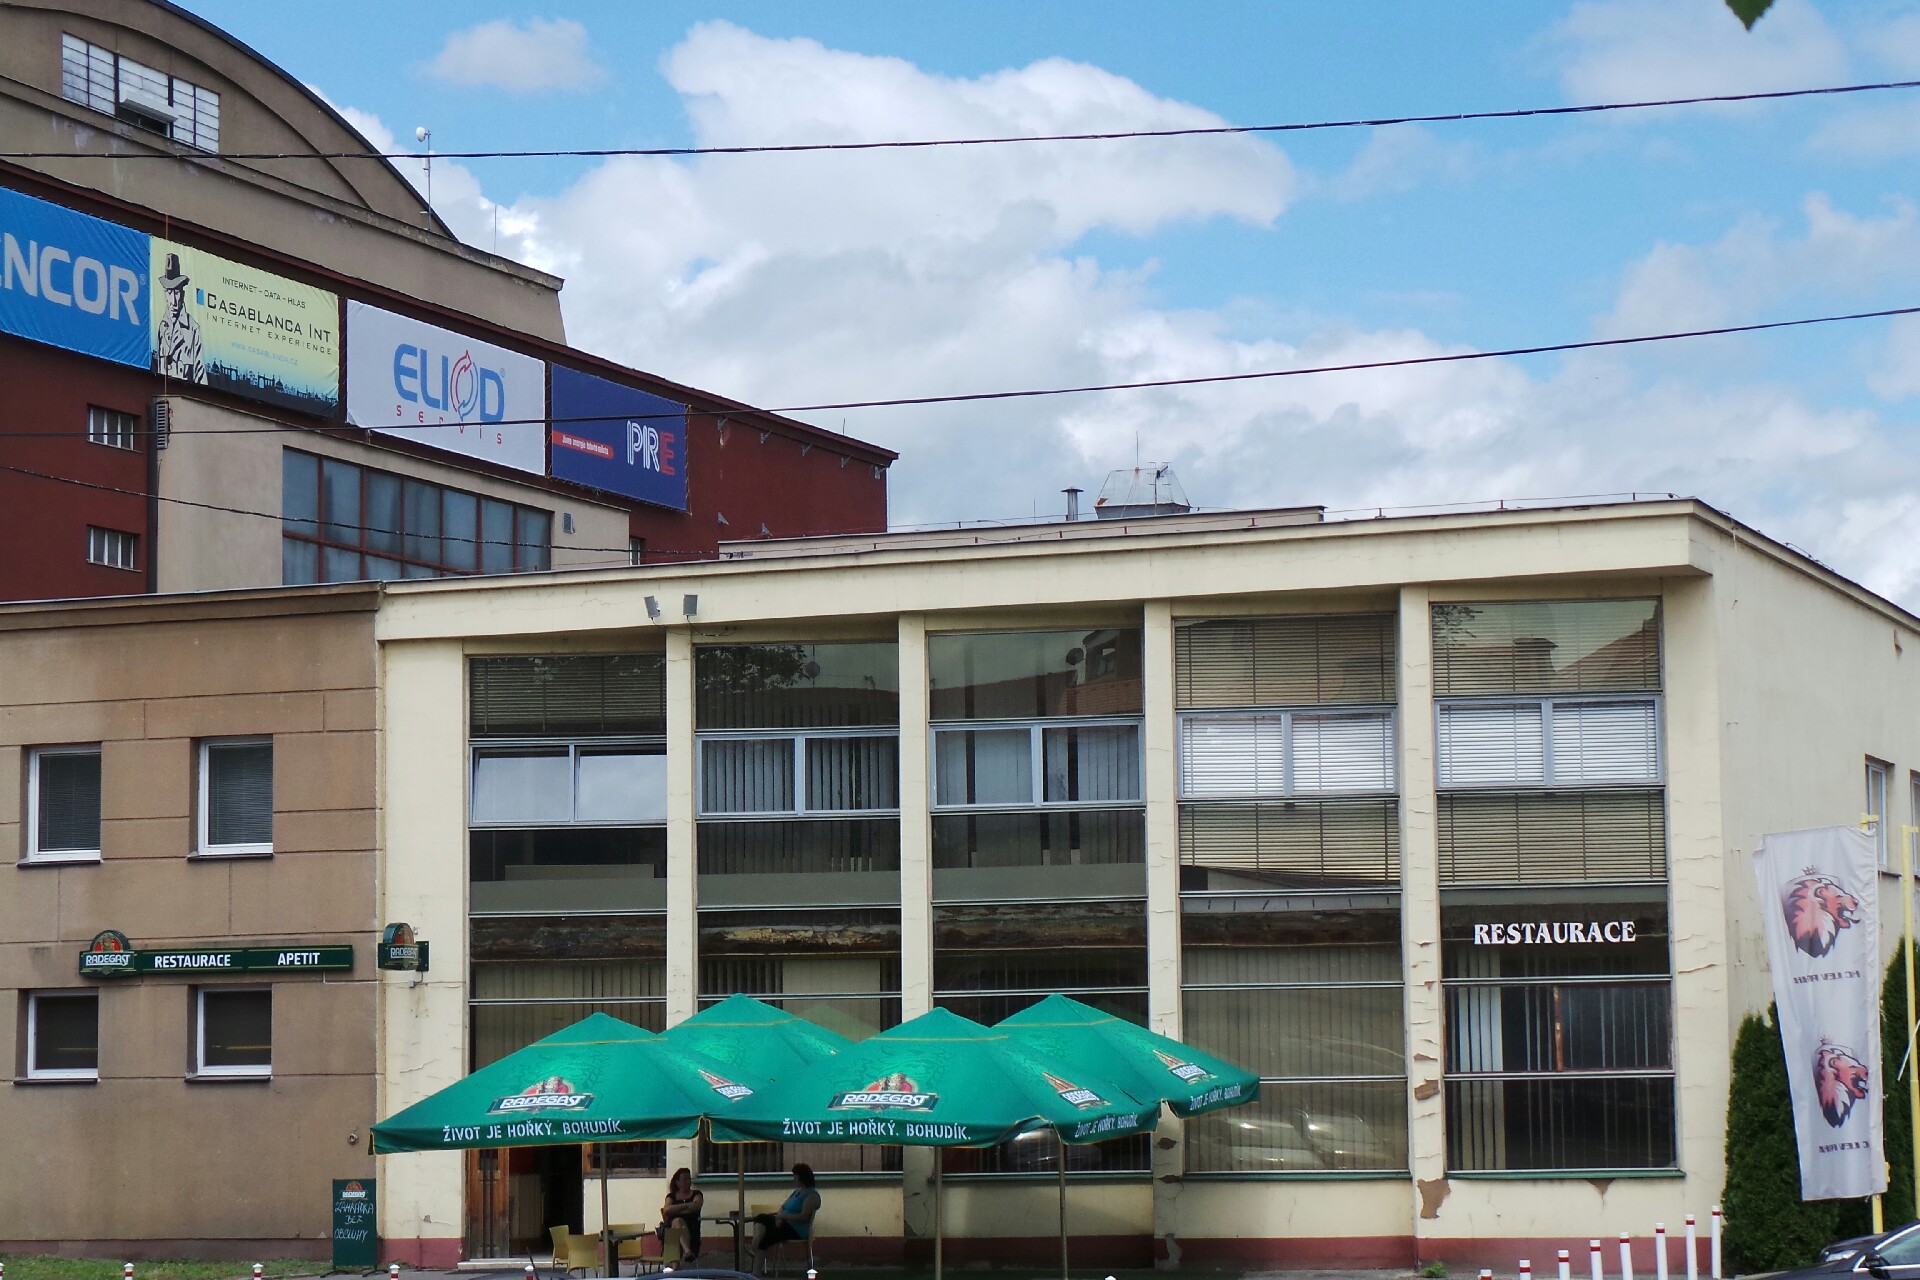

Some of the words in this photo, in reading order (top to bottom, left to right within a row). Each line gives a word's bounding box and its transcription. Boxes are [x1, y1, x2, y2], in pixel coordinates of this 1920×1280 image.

[0, 232, 140, 326] NCOR
[222, 276, 258, 294] INTERNET
[264, 289, 282, 302] DATA
[287, 297, 306, 309] HLAS
[207, 293, 302, 336] CASABLANCA
[309, 323, 331, 343] INT
[206, 311, 261, 335] INTERNET
[267, 331, 332, 355] EXPERIENCE
[626, 420, 676, 476] PRE
[1474, 921, 1637, 945] RESTAURACE
[85, 954, 131, 967] RADEGAST
[154, 954, 231, 968] RESTAURACE
[277, 952, 320, 966] APETIT
[500, 1094, 586, 1109] RADEGAST
[841, 1092, 930, 1107] RADEGAST
[442, 1125, 481, 1142] ŽIVOT
[486, 1125, 502, 1140] JE
[507, 1119, 557, 1138] HOŘKÝ.
[563, 1117, 626, 1136] BOHUDÍK.
[782, 1118, 821, 1135] ŽIVOT
[827, 1121, 844, 1136] JE
[849, 1117, 899, 1137] HOŘKÝ.
[906, 1122, 971, 1141] BOHUDÍK.
